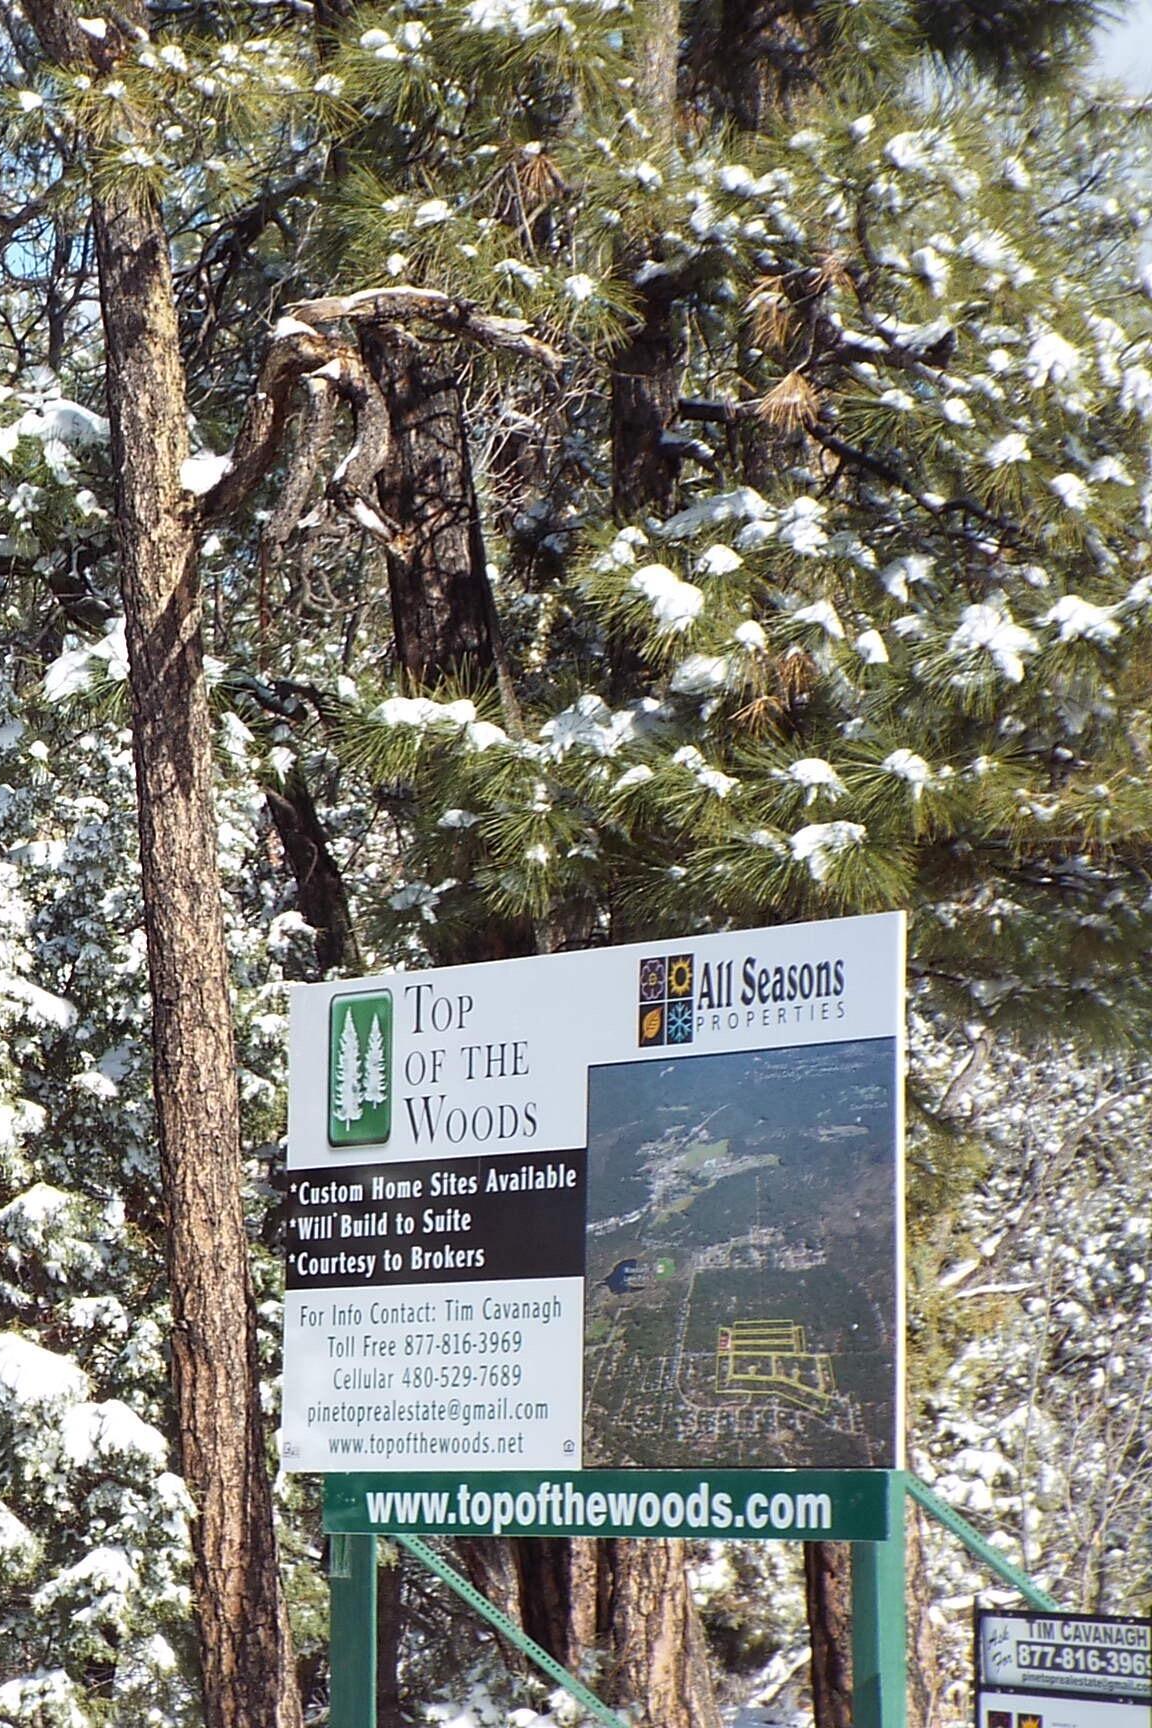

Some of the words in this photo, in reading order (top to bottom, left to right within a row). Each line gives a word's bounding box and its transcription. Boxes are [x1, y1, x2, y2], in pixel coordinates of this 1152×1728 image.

[698, 960, 733, 1010] All
[741, 956, 845, 1007] Seasons
[404, 984, 474, 1034] TOP
[697, 1001, 846, 1032] PROPERTIES
[404, 1049, 446, 1086] OF
[461, 1041, 530, 1080] THE
[404, 1094, 538, 1145] WOODS
[372, 1176, 423, 1200] Home
[430, 1172, 478, 1196] Sites
[486, 1164, 577, 1193] Available
[340, 1211, 388, 1238] Build
[395, 1213, 415, 1235] to
[422, 1208, 472, 1233] Suite
[384, 1250, 403, 1272] to
[410, 1245, 485, 1271] Brokers
[300, 1306, 324, 1327] For
[332, 1304, 362, 1326] Info
[370, 1302, 436, 1325] Contact:
[445, 1299, 474, 1321] Tim
[482, 1296, 562, 1324] Cavanagh
[328, 1336, 355, 1358] Toll
[363, 1335, 397, 1357] Free
[404, 1331, 523, 1355] 877-816-3969
[333, 1369, 394, 1390] Cellular
[401, 1365, 523, 1389] 480-529-7689
[307, 1399, 549, 1427] pinetoprealestate@gmail.com
[328, 1432, 524, 1459] www.topofthewoods.net
[365, 1482, 832, 1535] www.topofthewoods.com
[1026, 1619, 1055, 1639] TIM
[1060, 1622, 1148, 1647] CAVANAGH
